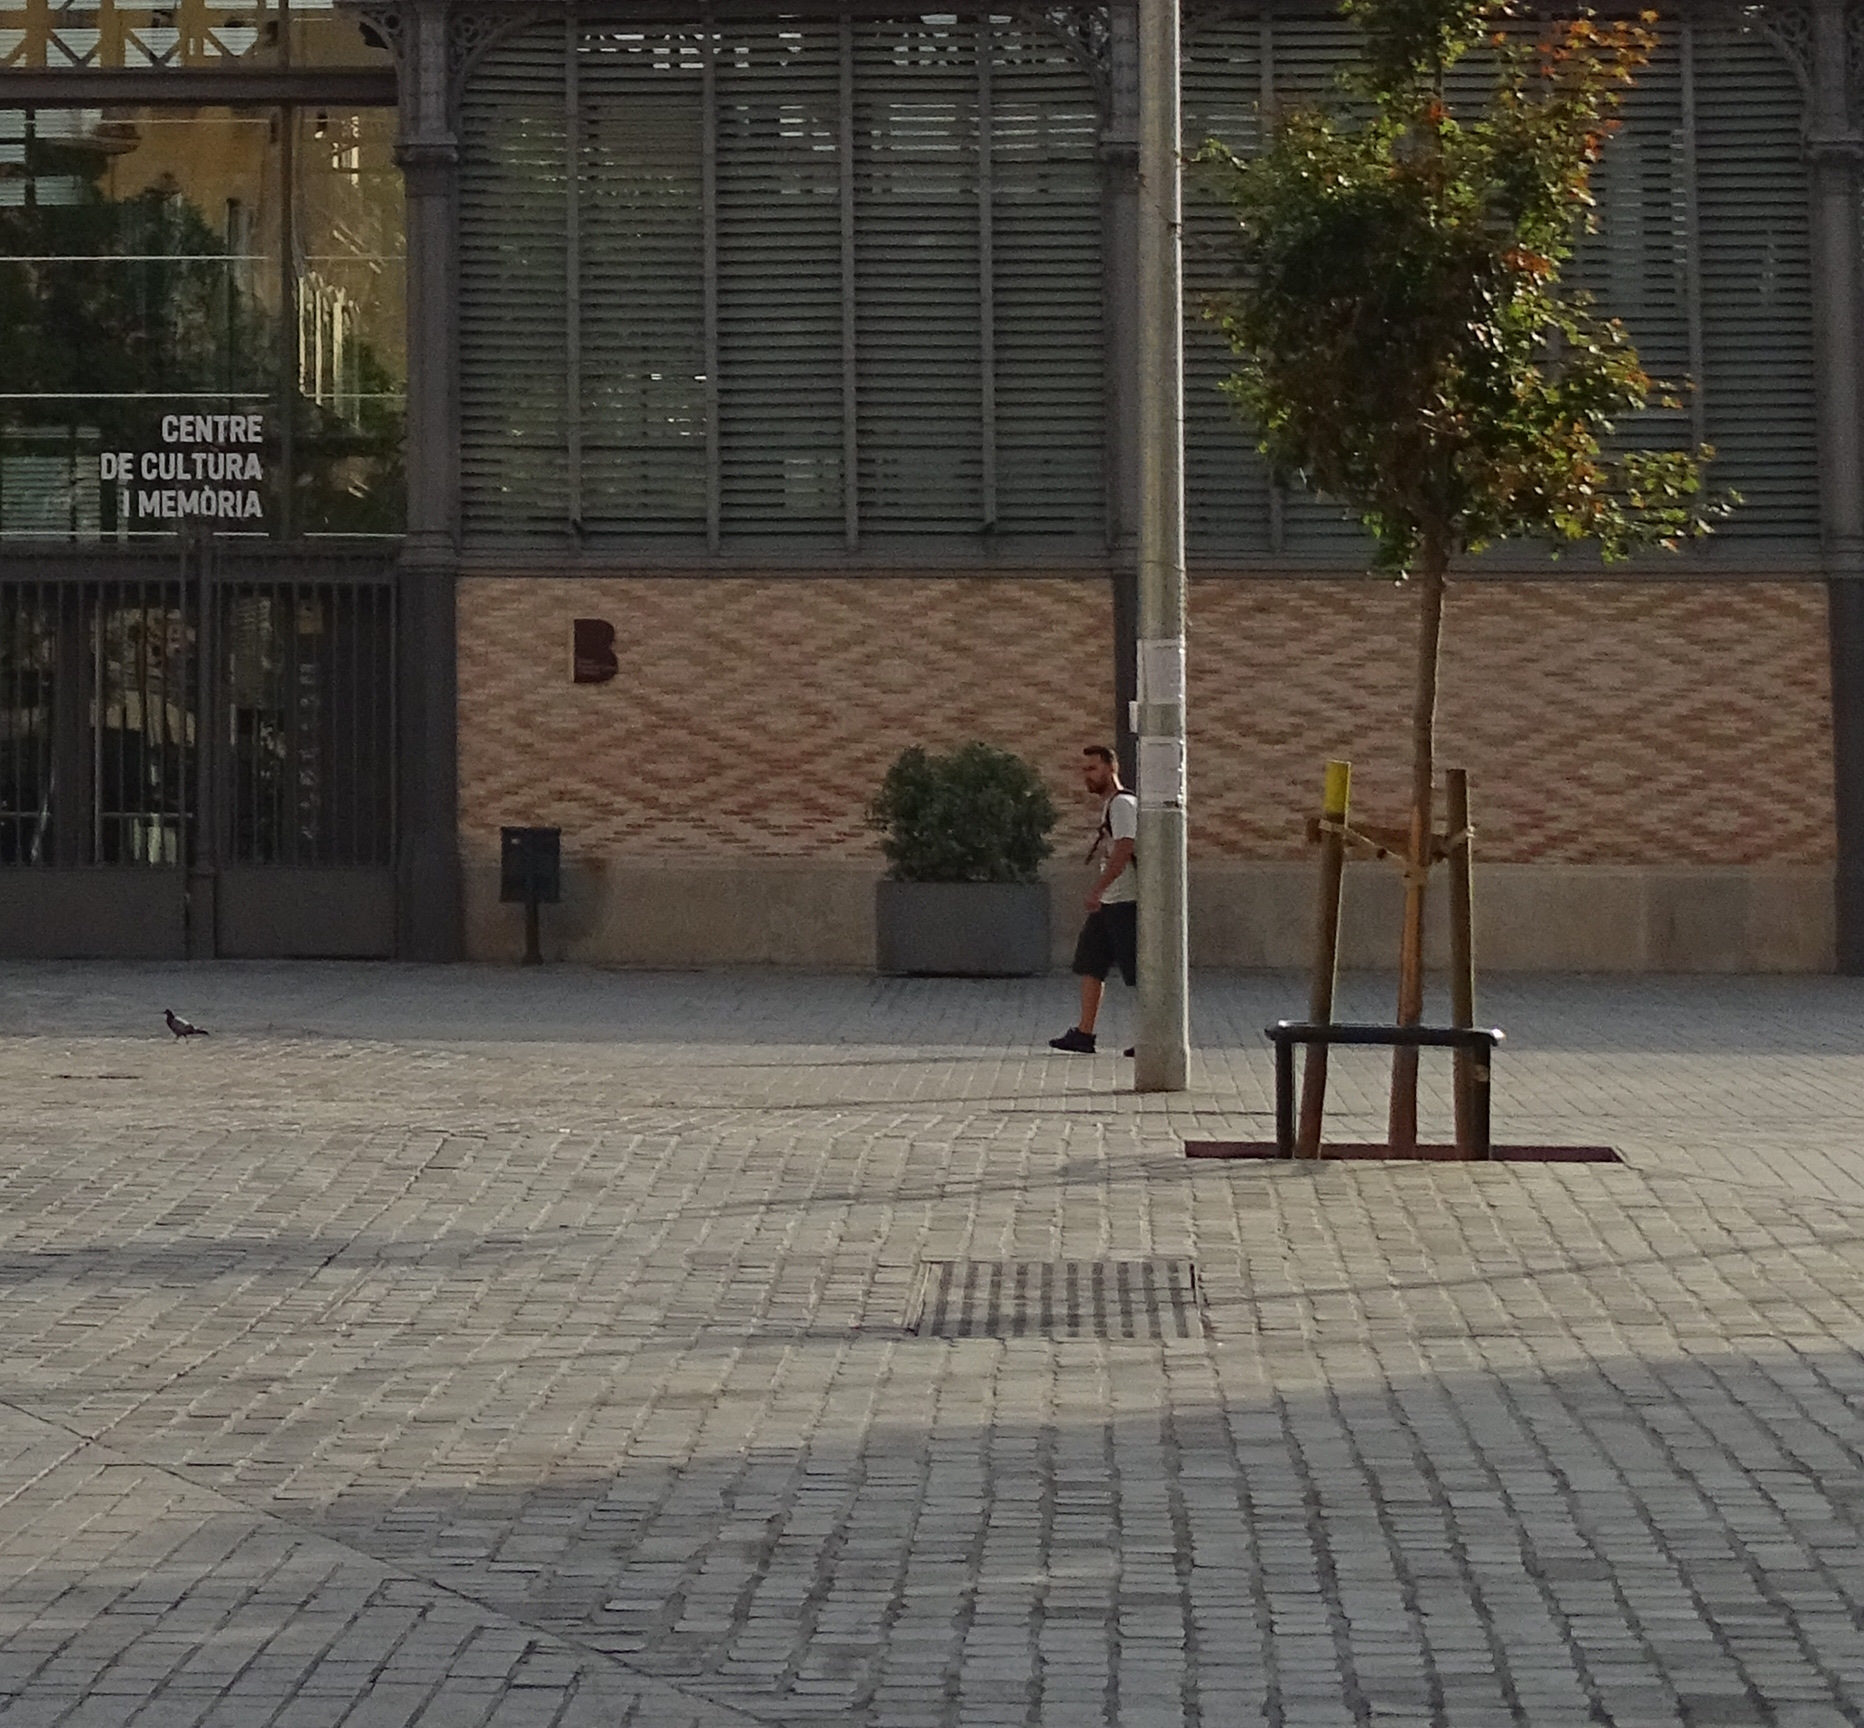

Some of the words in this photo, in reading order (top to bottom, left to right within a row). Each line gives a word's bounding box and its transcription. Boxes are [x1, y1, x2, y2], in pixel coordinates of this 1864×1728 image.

[161, 415, 264, 443] CENTRE
[100, 452, 134, 481] DE
[140, 452, 263, 481] CULTURA
[121, 488, 130, 518] I
[138, 484, 264, 518] MEMÒRIA
